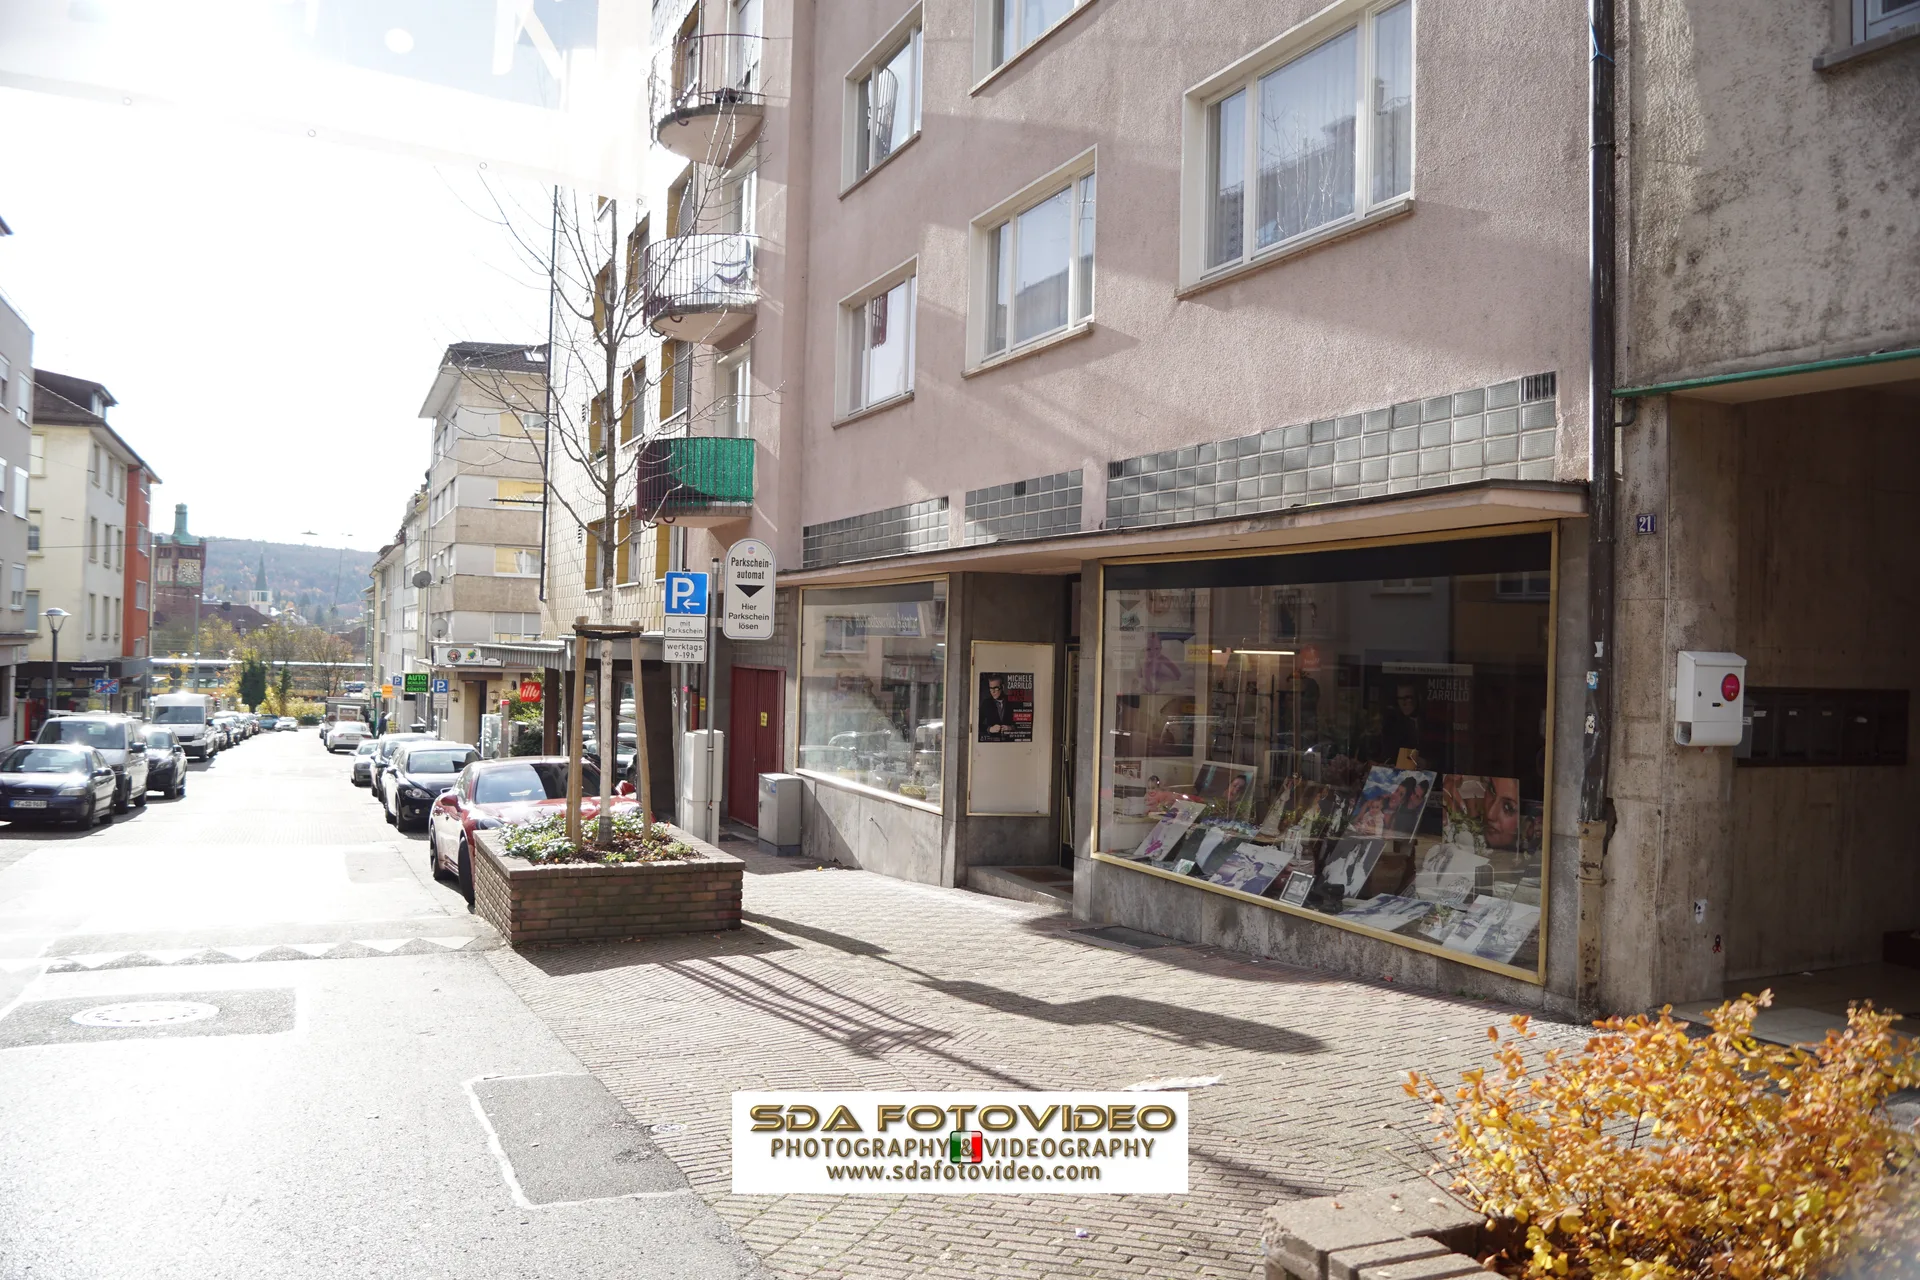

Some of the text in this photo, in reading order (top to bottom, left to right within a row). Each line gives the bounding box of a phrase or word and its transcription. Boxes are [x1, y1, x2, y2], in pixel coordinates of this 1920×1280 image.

[1639, 515, 1652, 532] 21
[731, 556, 772, 568] Parkschein-
[736, 569, 765, 580] automat
[671, 577, 695, 609] P
[741, 603, 757, 611] Hier
[728, 612, 770, 621] Parkschein
[667, 626, 703, 634] Parkschein
[738, 622, 759, 630] lösen
[666, 643, 703, 652] werktags
[394, 677, 401, 685] P
[436, 681, 446, 692] P
[1427, 678, 1470, 690] MICHELE
[522, 684, 539, 699] illy
[1427, 689, 1470, 702] ZARRILLO
